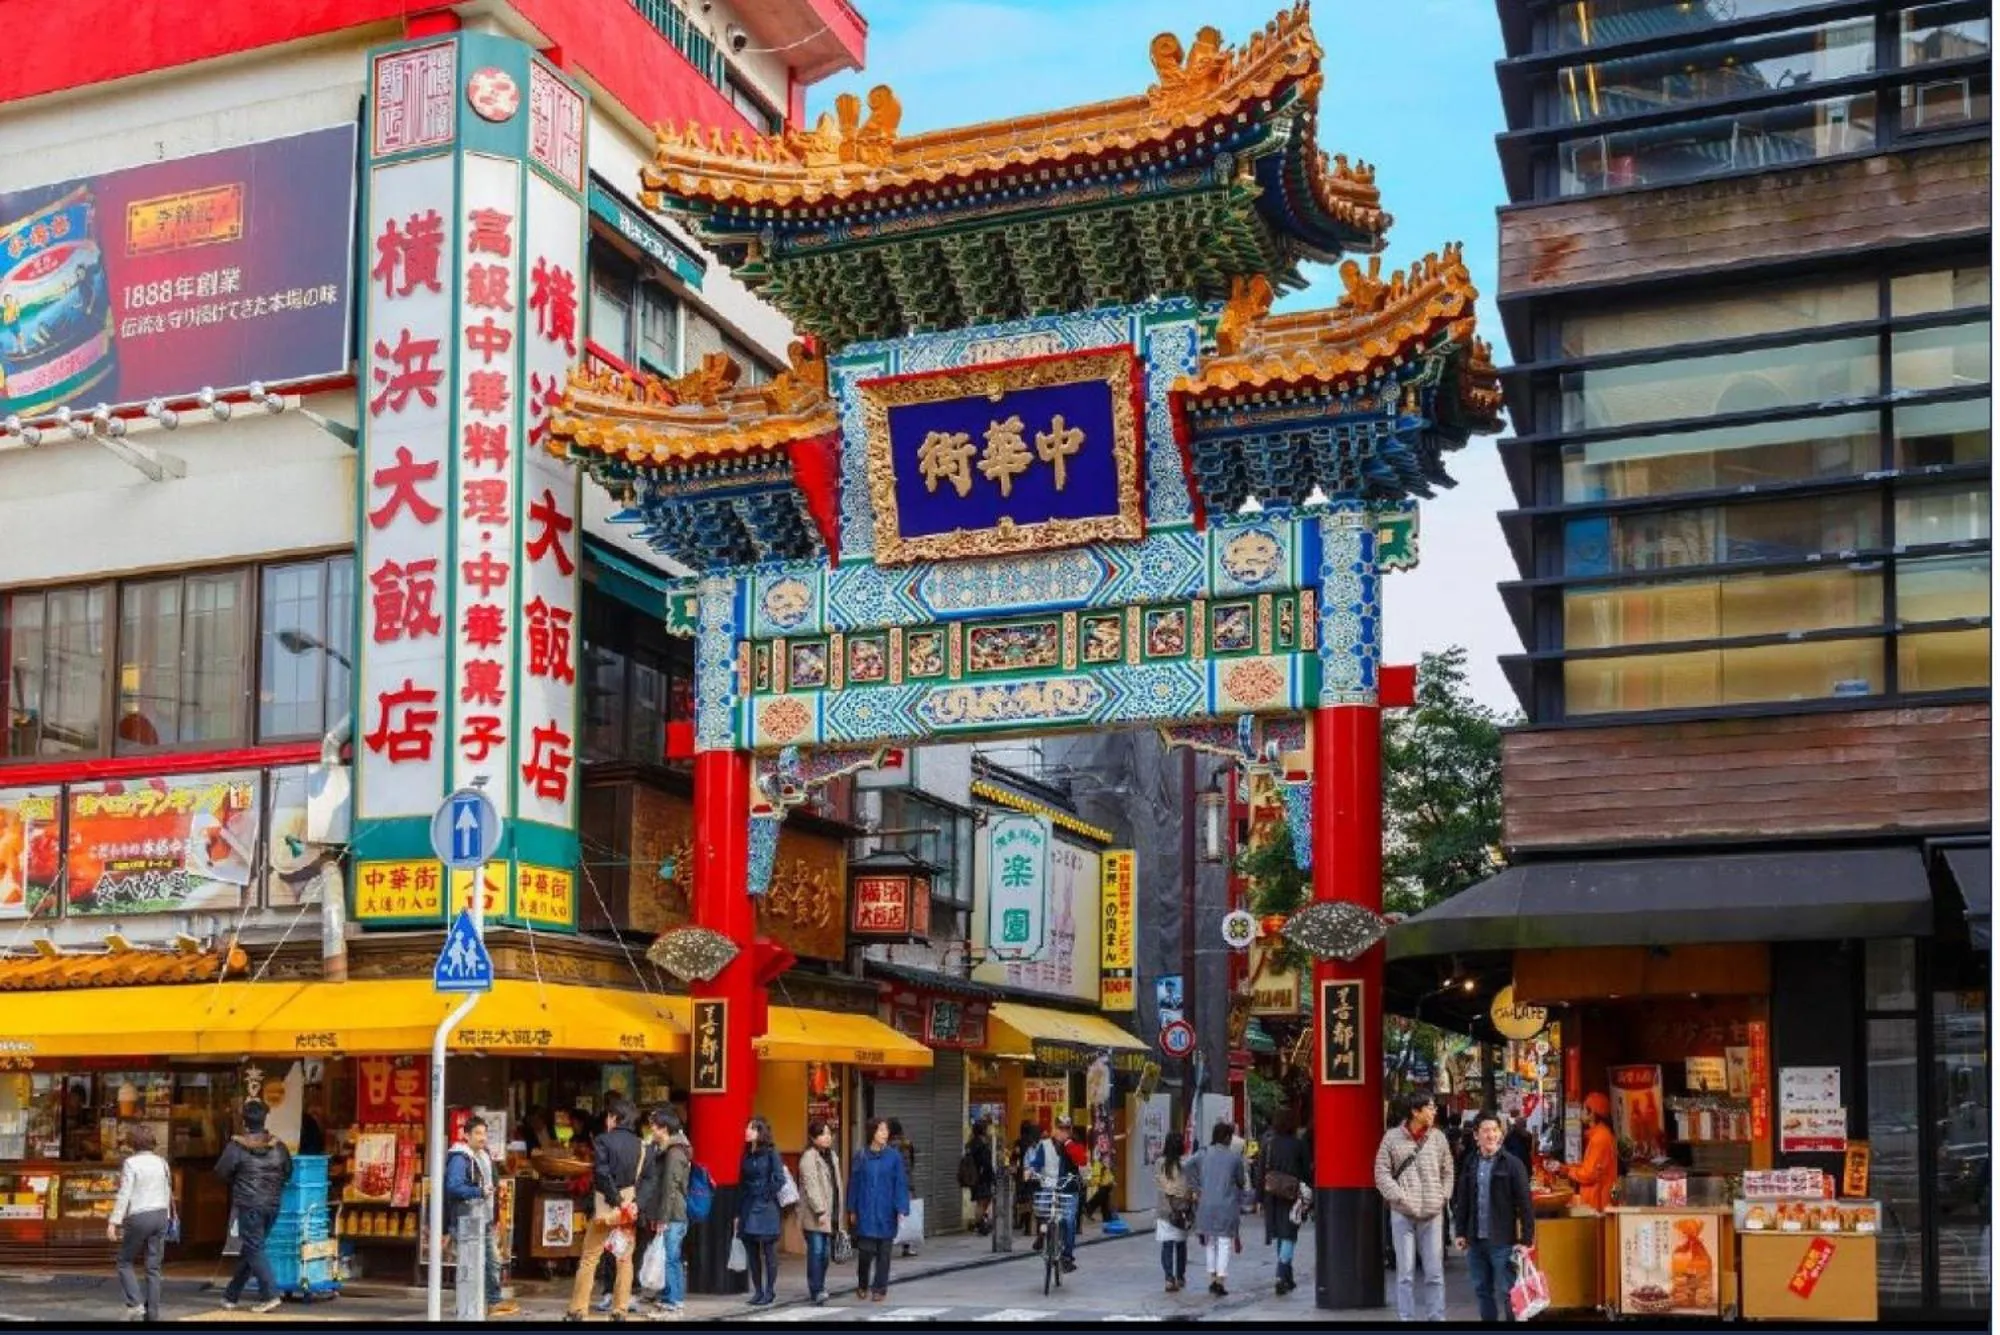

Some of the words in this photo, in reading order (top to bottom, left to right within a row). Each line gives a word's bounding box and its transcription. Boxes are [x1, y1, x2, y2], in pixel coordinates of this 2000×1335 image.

[122, 265, 242, 312] 1888年創業
[365, 208, 446, 764] 横浜大飯店
[364, 866, 441, 893] 中華街
[1001, 854, 1035, 943] 楽園
[1170, 1030, 1189, 1048] 30
